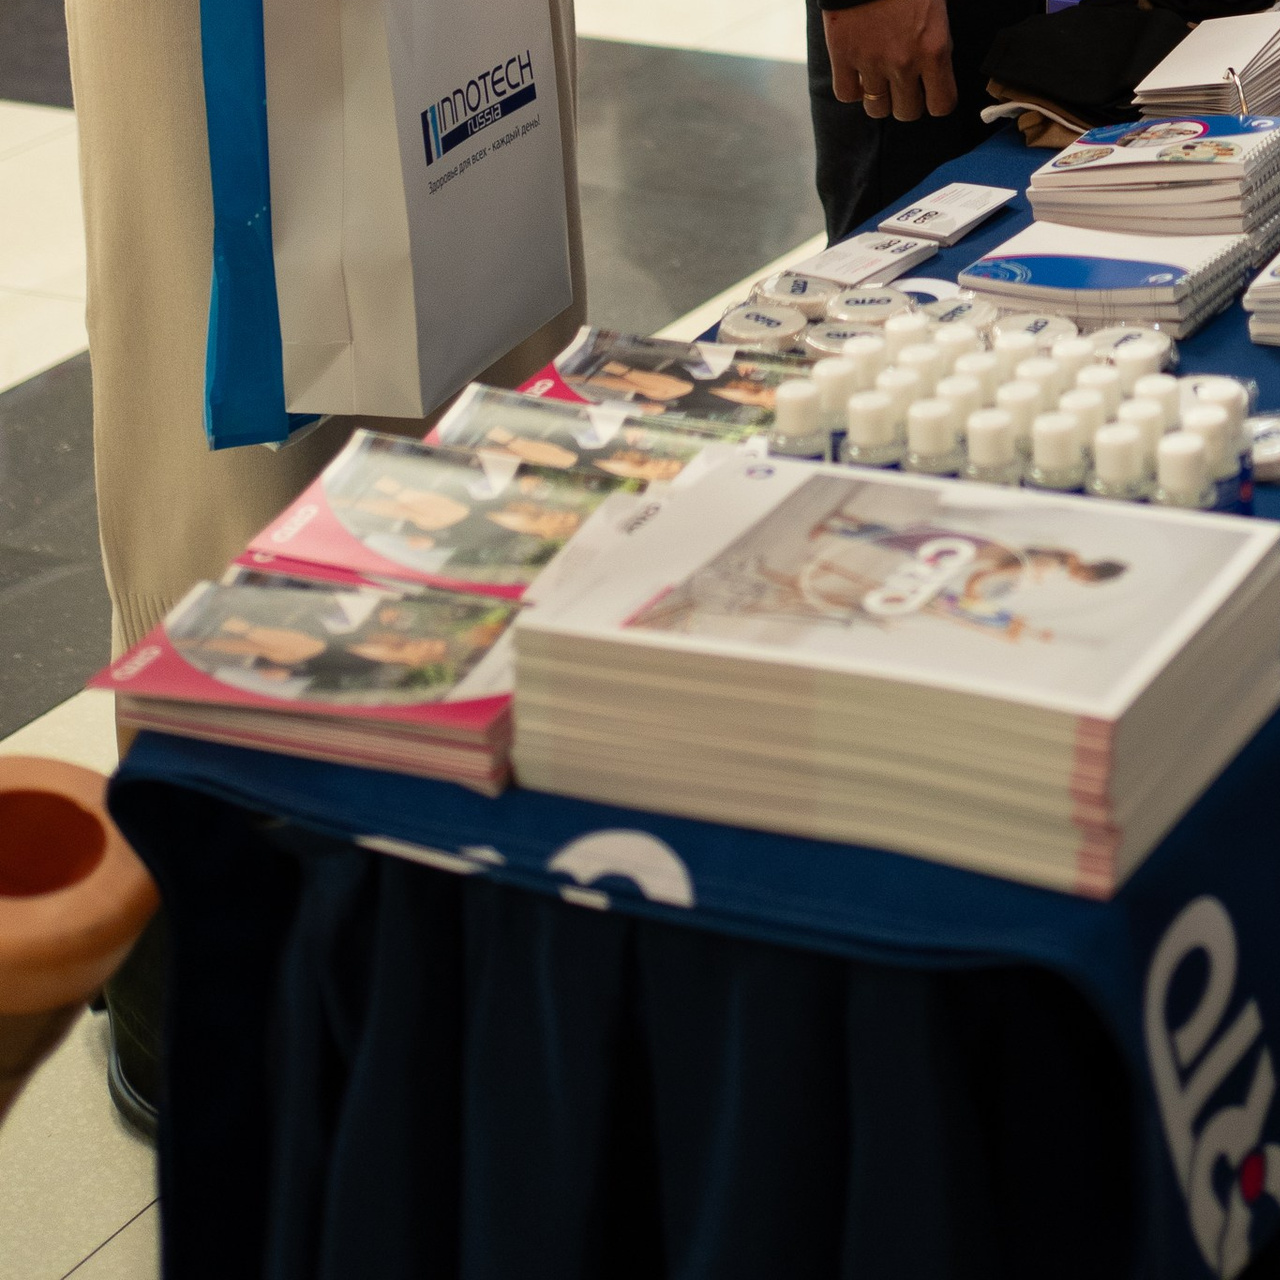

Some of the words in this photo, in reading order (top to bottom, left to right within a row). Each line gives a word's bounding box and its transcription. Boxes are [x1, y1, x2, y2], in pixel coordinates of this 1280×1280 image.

[467, 104, 502, 135] russia
[428, 165, 458, 195] Здоровье
[458, 157, 472, 175] для
[471, 148, 488, 165] всех
[492, 126, 521, 151] каждый
[521, 114, 541, 136] день!
[896, 208, 923, 221] ORTO
[913, 211, 939, 225] ORTO
